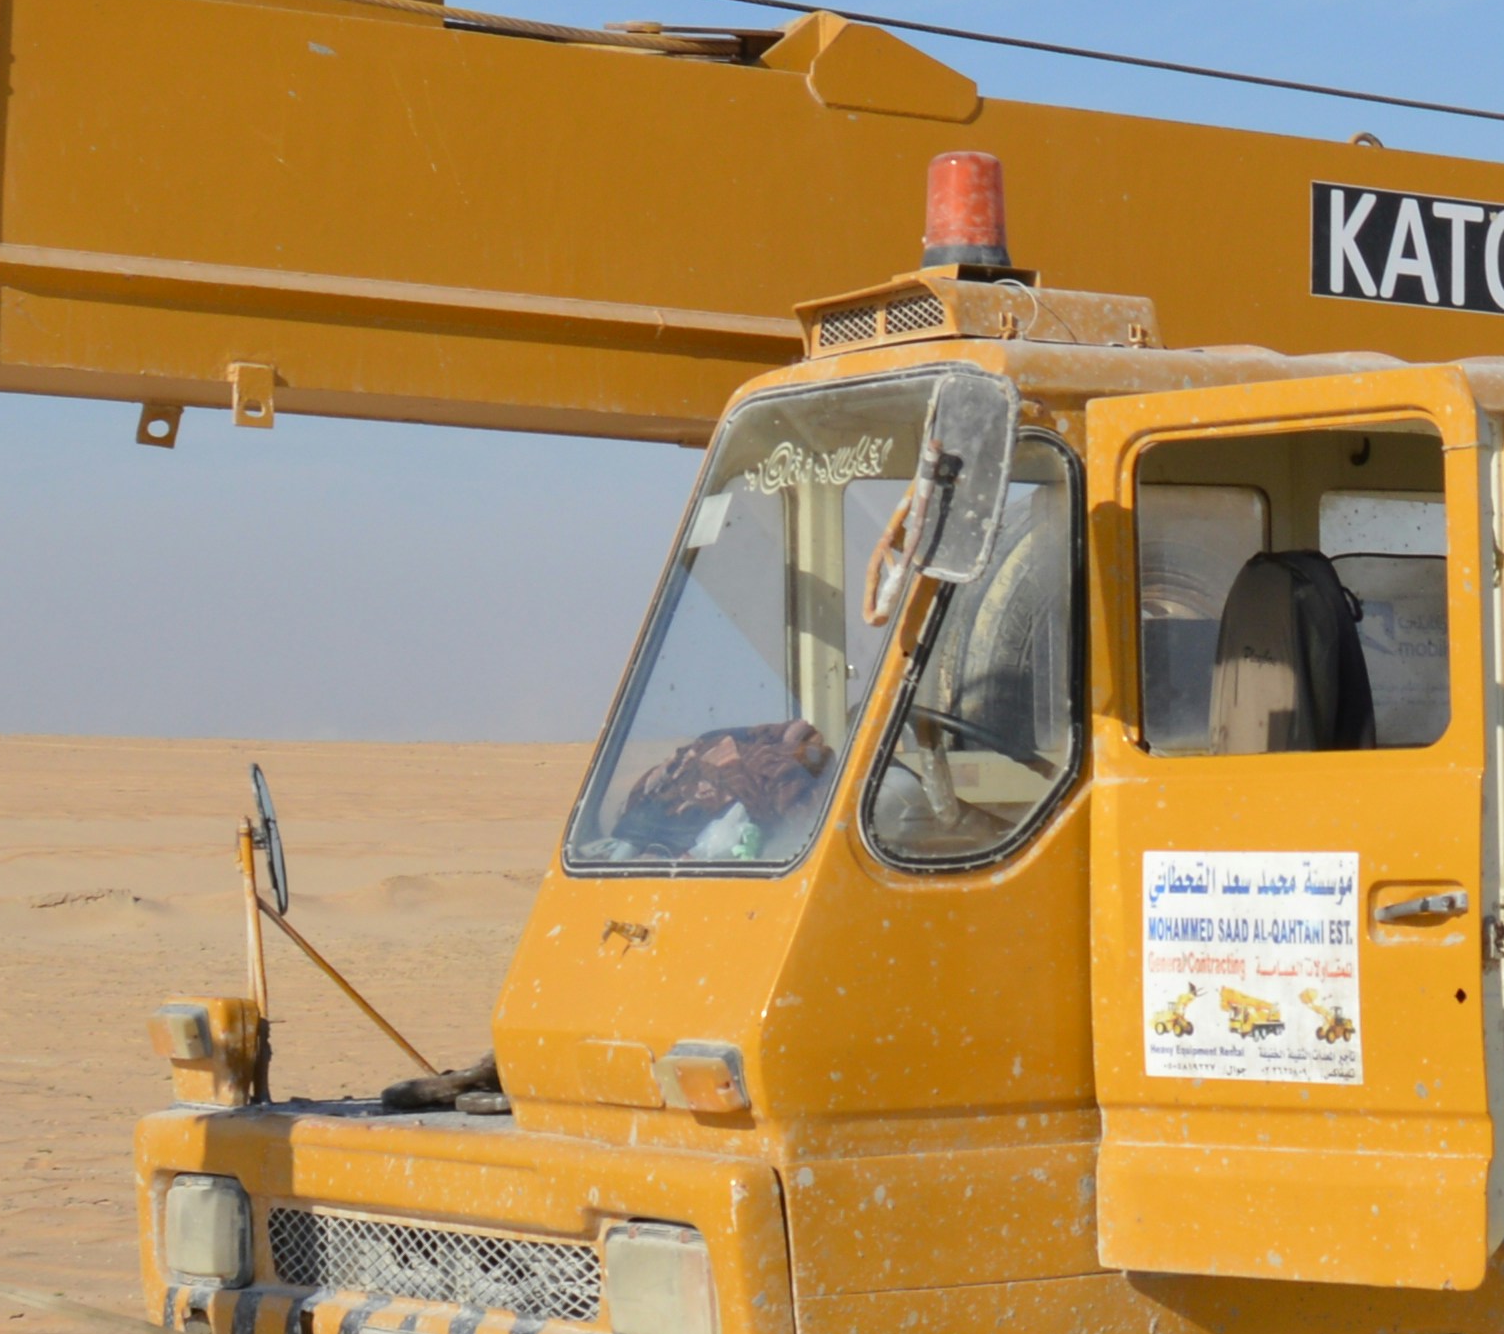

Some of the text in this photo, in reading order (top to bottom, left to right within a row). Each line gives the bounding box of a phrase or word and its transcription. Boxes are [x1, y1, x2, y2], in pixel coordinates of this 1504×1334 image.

[1149, 861, 1354, 908] مؤسسة محمد سعد القحطاني
[1148, 917, 1354, 945] MOHAMMED SAAD AL-QAHTANI EST.
[1149, 951, 1246, 981] General Contracting
[1150, 1044, 1245, 1058] Heavy Equipment Rental
